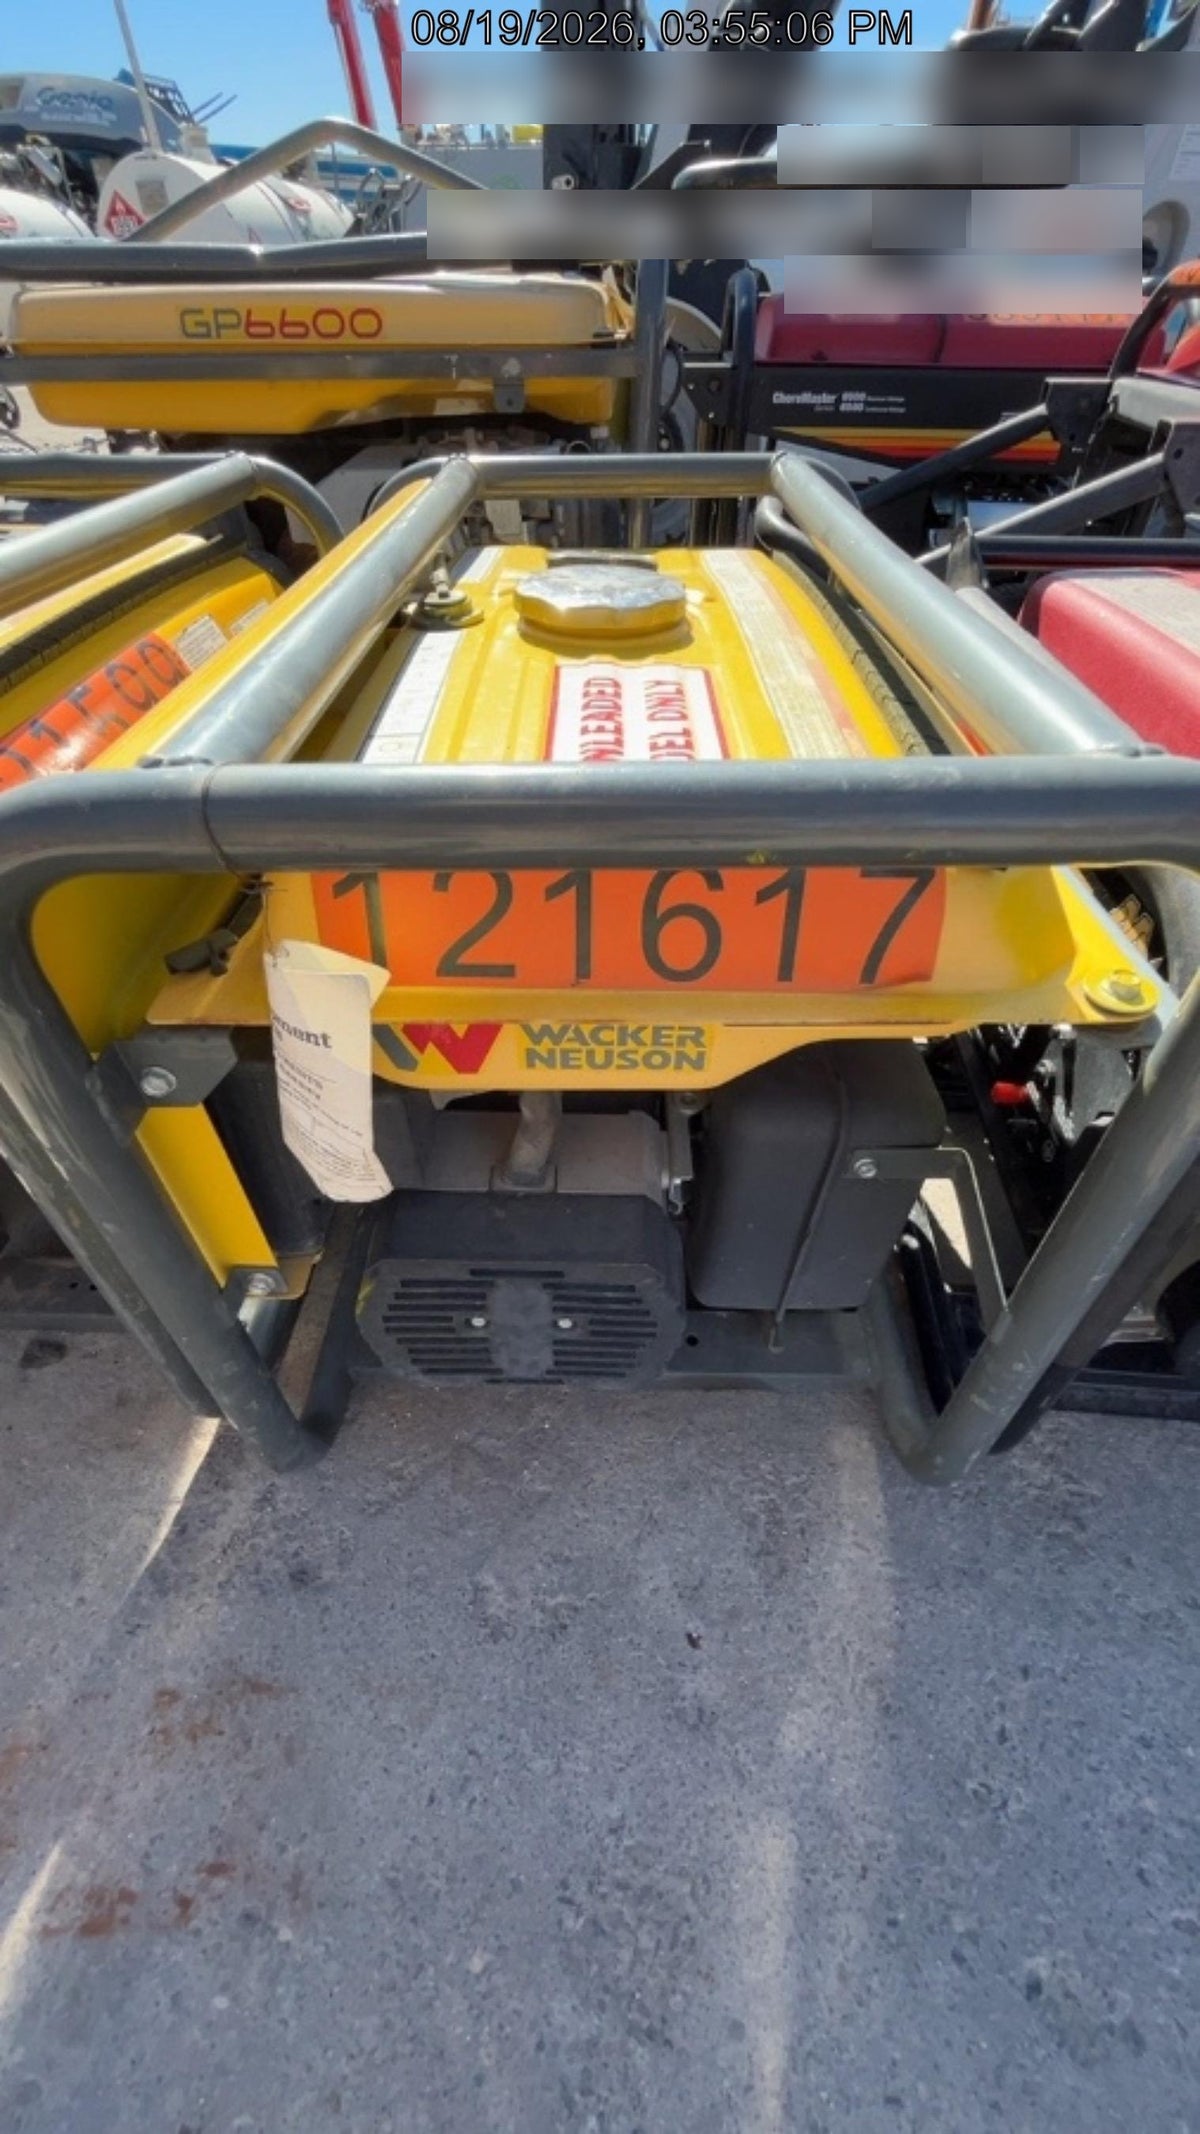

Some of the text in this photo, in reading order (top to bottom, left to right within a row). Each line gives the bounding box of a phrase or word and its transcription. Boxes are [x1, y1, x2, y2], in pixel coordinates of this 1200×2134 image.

[179, 307, 383, 340] GP6600
[644, 680, 688, 722] ONLY
[580, 678, 625, 762] NLEADED
[332, 868, 936, 985] 121617
[521, 1024, 707, 1047] WACKER
[525, 1048, 707, 1071] NEUSON
